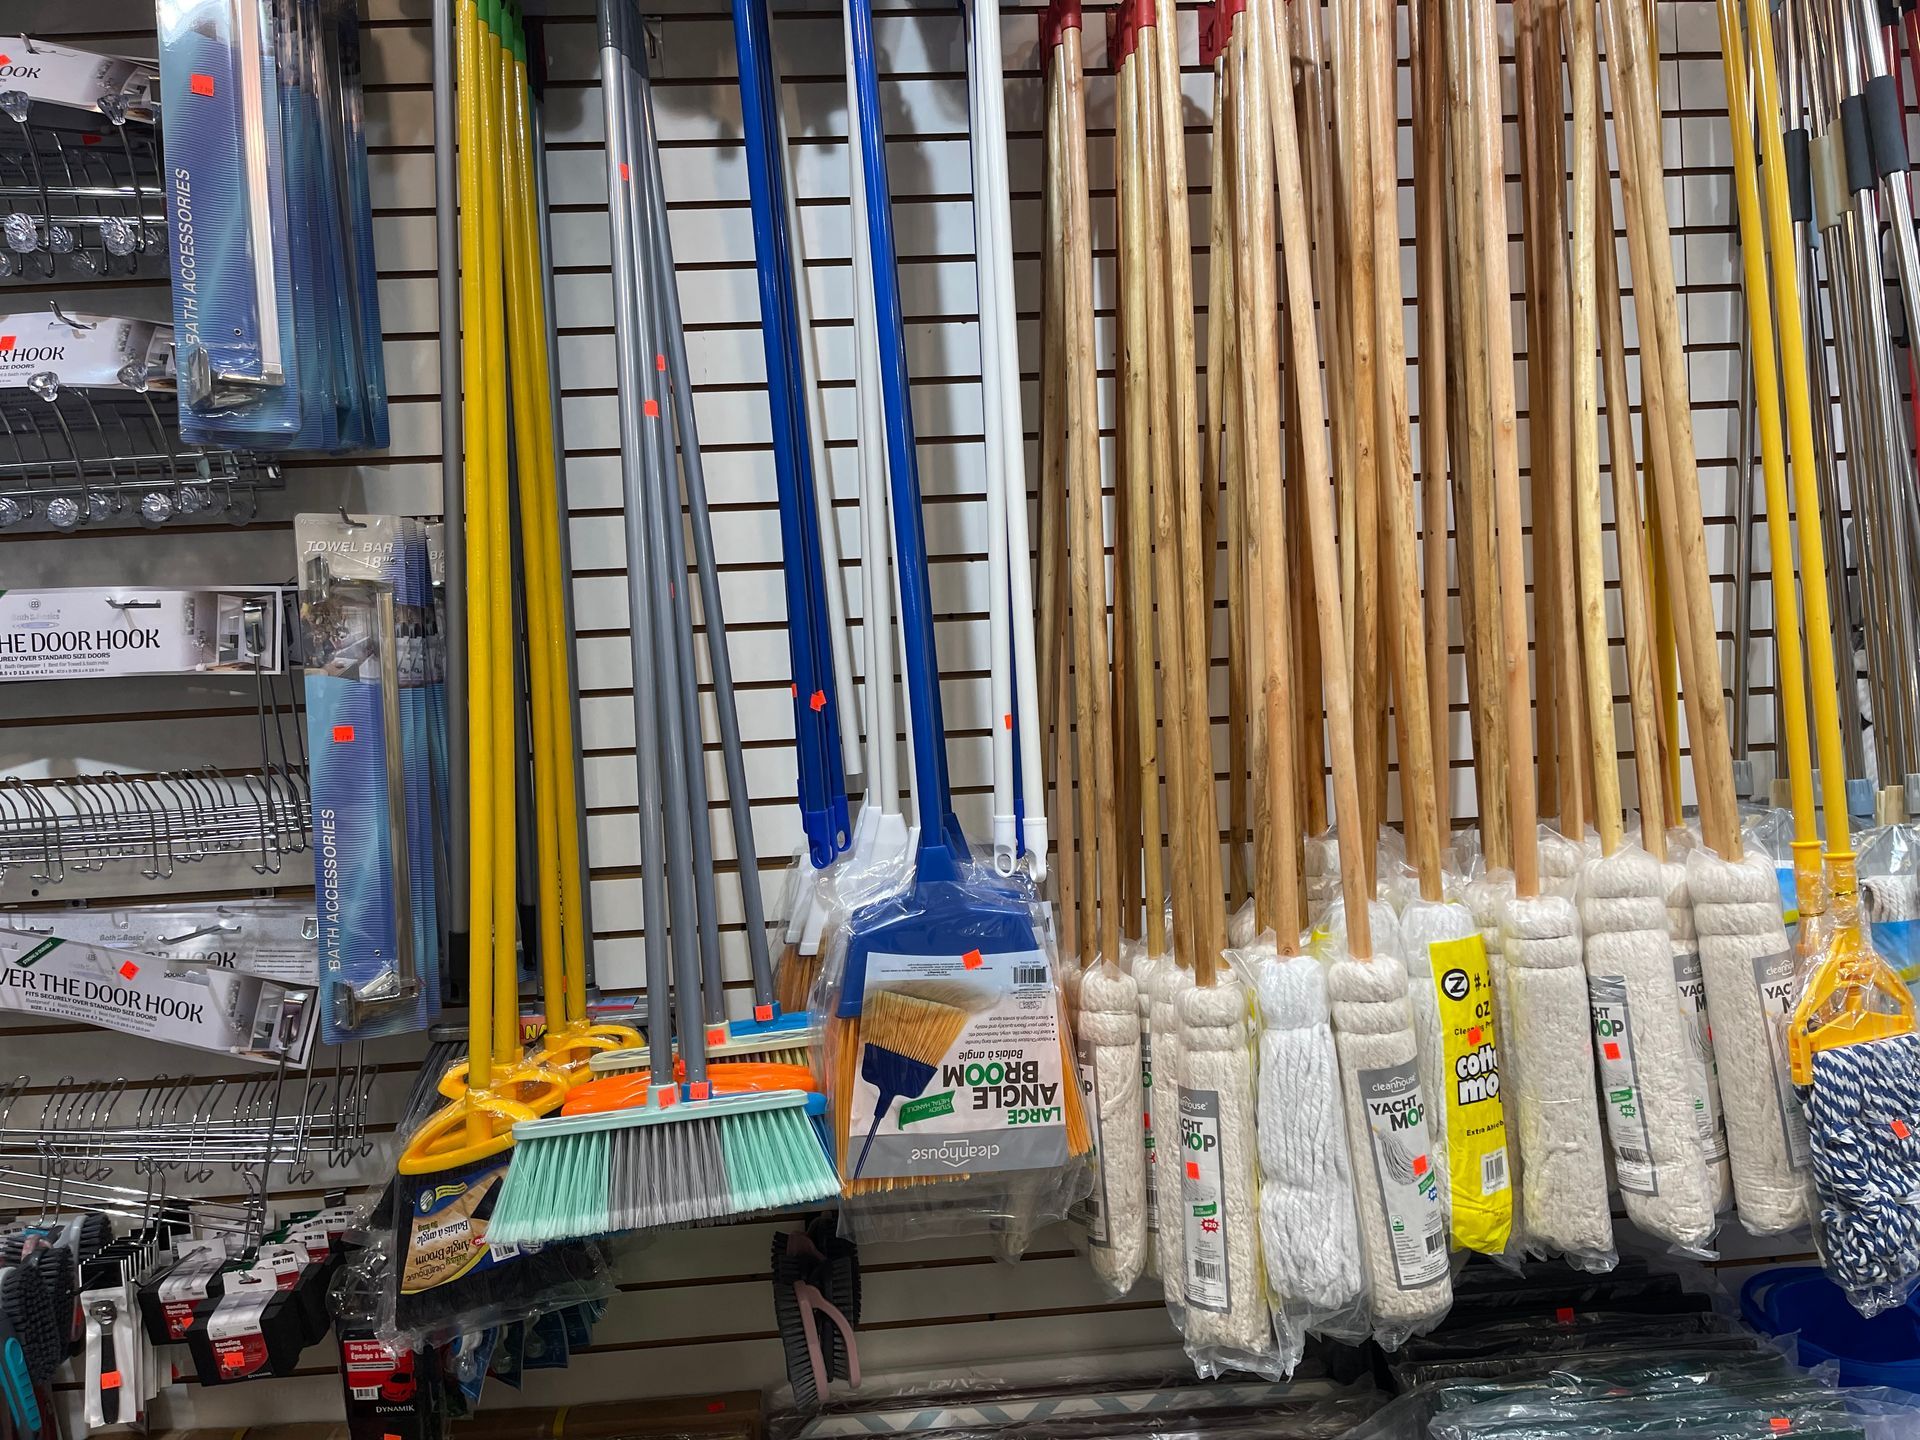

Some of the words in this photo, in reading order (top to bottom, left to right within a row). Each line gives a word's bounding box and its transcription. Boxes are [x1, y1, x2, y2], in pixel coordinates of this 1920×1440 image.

[175, 168, 197, 295] ACCESSORIES
[184, 297, 200, 345] BATH
[12, 346, 65, 362] HOOK
[306, 540, 359, 552] TOWEL
[362, 542, 394, 553] BAR
[31, 630, 93, 653] DOOR
[97, 628, 161, 650] HOOK
[38, 653, 72, 661] STANDARD
[321, 808, 340, 924] ACCESSORIES
[327, 926, 341, 973] BATH
[1448, 976, 1465, 993] Z
[1679, 982, 1705, 998] YAC
[1765, 982, 1792, 999] YAC
[25, 990, 40, 998] FITS
[40, 993, 72, 1003] SECURELY
[72, 998, 89, 1007] OVER
[89, 1001, 122, 1014] STANDARD
[122, 1007, 135, 1017] SIZE
[136, 1011, 158, 1022] DOORS
[40, 972, 81, 998] THE
[85, 981, 142, 1010] DOOR
[146, 993, 204, 1024] HOOK
[958, 1050, 985, 1062] angle
[987, 1051, 994, 1060] à
[995, 1049, 1024, 1060] Balais
[942, 1060, 1039, 1088] BROOM
[1371, 1074, 1416, 1092] cleanhouse
[972, 1082, 1059, 1110] ANGLE
[1457, 1072, 1501, 1106] mo
[1370, 1094, 1417, 1116] YACHT
[1007, 1106, 1061, 1125] LARGE
[1390, 1103, 1425, 1132] MOP
[1181, 1128, 1217, 1152] MOP
[1466, 1128, 1486, 1137] Extra
[911, 1144, 1000, 1161] cleanhouse
[436, 1229, 444, 1239] à
[444, 1219, 469, 1235] Balais
[416, 1230, 436, 1247] angle
[445, 1239, 470, 1255] Angle
[415, 1247, 445, 1265] Broom
[406, 1264, 446, 1282] cleanhouse
[375, 1404, 416, 1414] DYNAMIK
